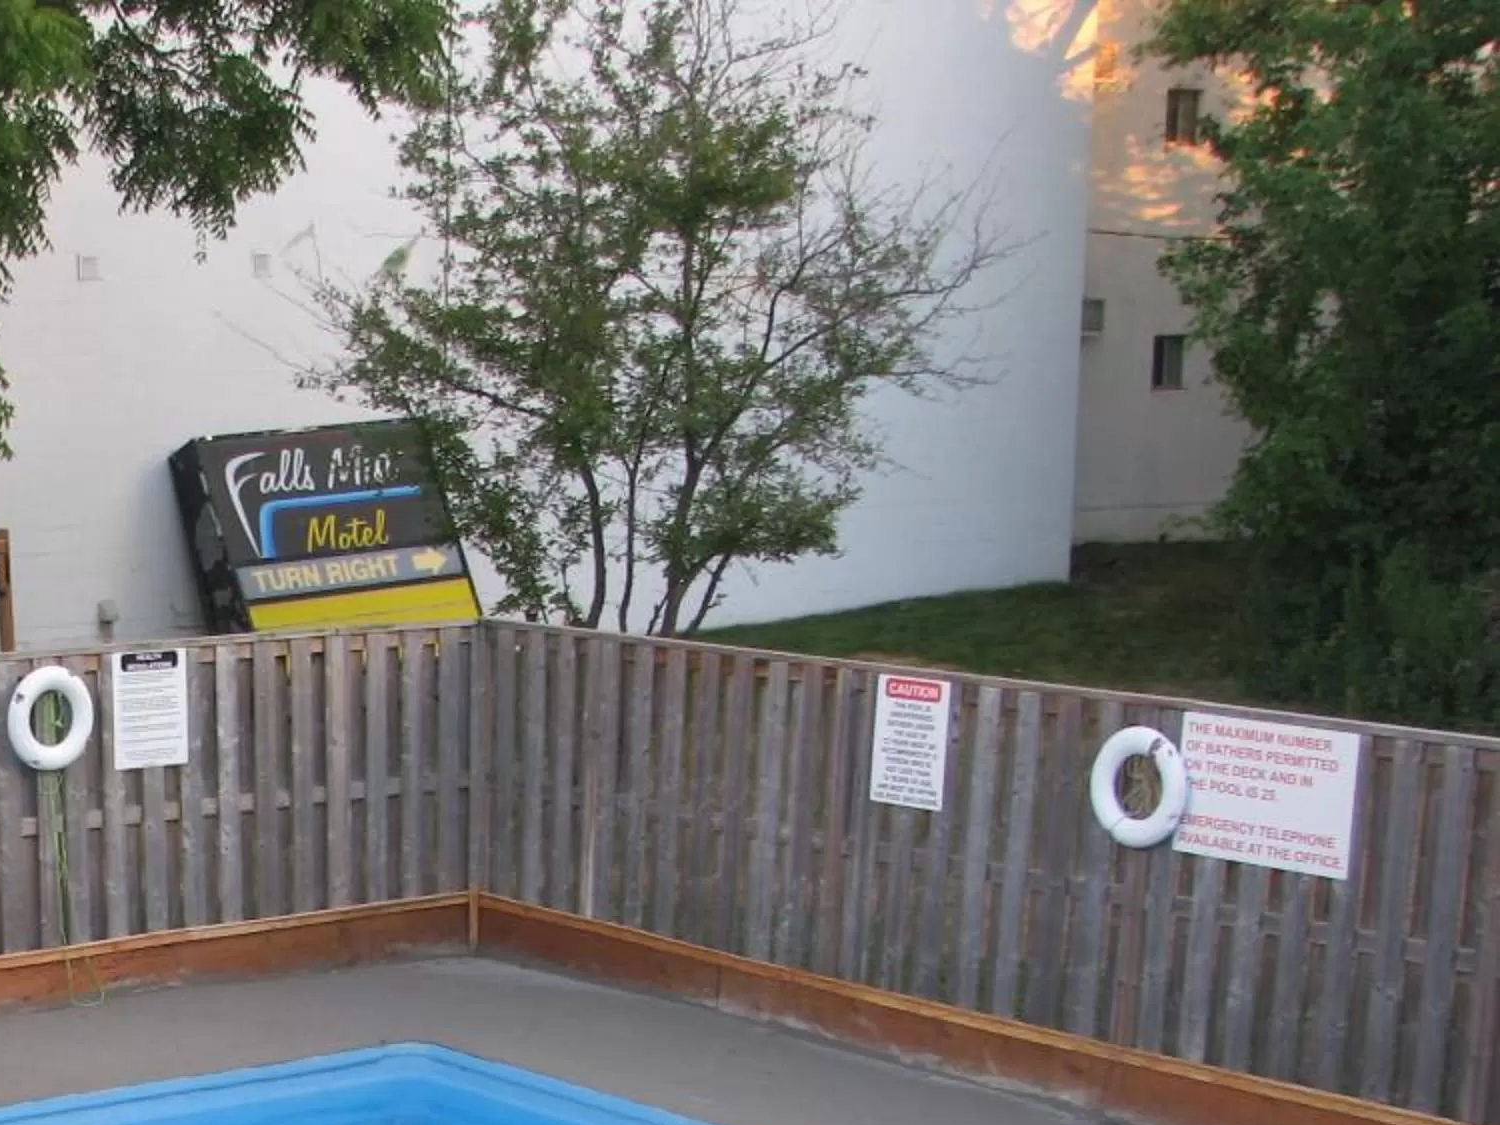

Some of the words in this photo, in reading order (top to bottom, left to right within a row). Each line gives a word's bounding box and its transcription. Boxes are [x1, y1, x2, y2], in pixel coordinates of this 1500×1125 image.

[225, 449, 315, 558] Falls
[307, 510, 388, 553] Motel
[252, 565, 323, 593] TURN
[329, 553, 397, 583] RIGHT
[889, 681, 939, 699] CAUTION
[1188, 722, 1212, 734] THE
[1215, 724, 1275, 743] MAXIMUM
[1278, 733, 1332, 752] NUMBER
[1186, 740, 1206, 752] OF
[1206, 742, 1263, 761] BATHERS
[1266, 751, 1339, 772] PERMITTED
[1207, 761, 1229, 776] THE
[1232, 765, 1266, 781] DECK
[1270, 771, 1297, 786] AND
[1300, 775, 1313, 787] IN
[1210, 779, 1244, 797] POOL
[1246, 786, 1258, 798] IS
[1178, 831, 1245, 853] AVAILABLE
[1248, 843, 1263, 855] AT
[1266, 846, 1292, 861] THE
[1180, 814, 1257, 836] EMERGENCY
[1260, 825, 1337, 848] TELEPHONE
